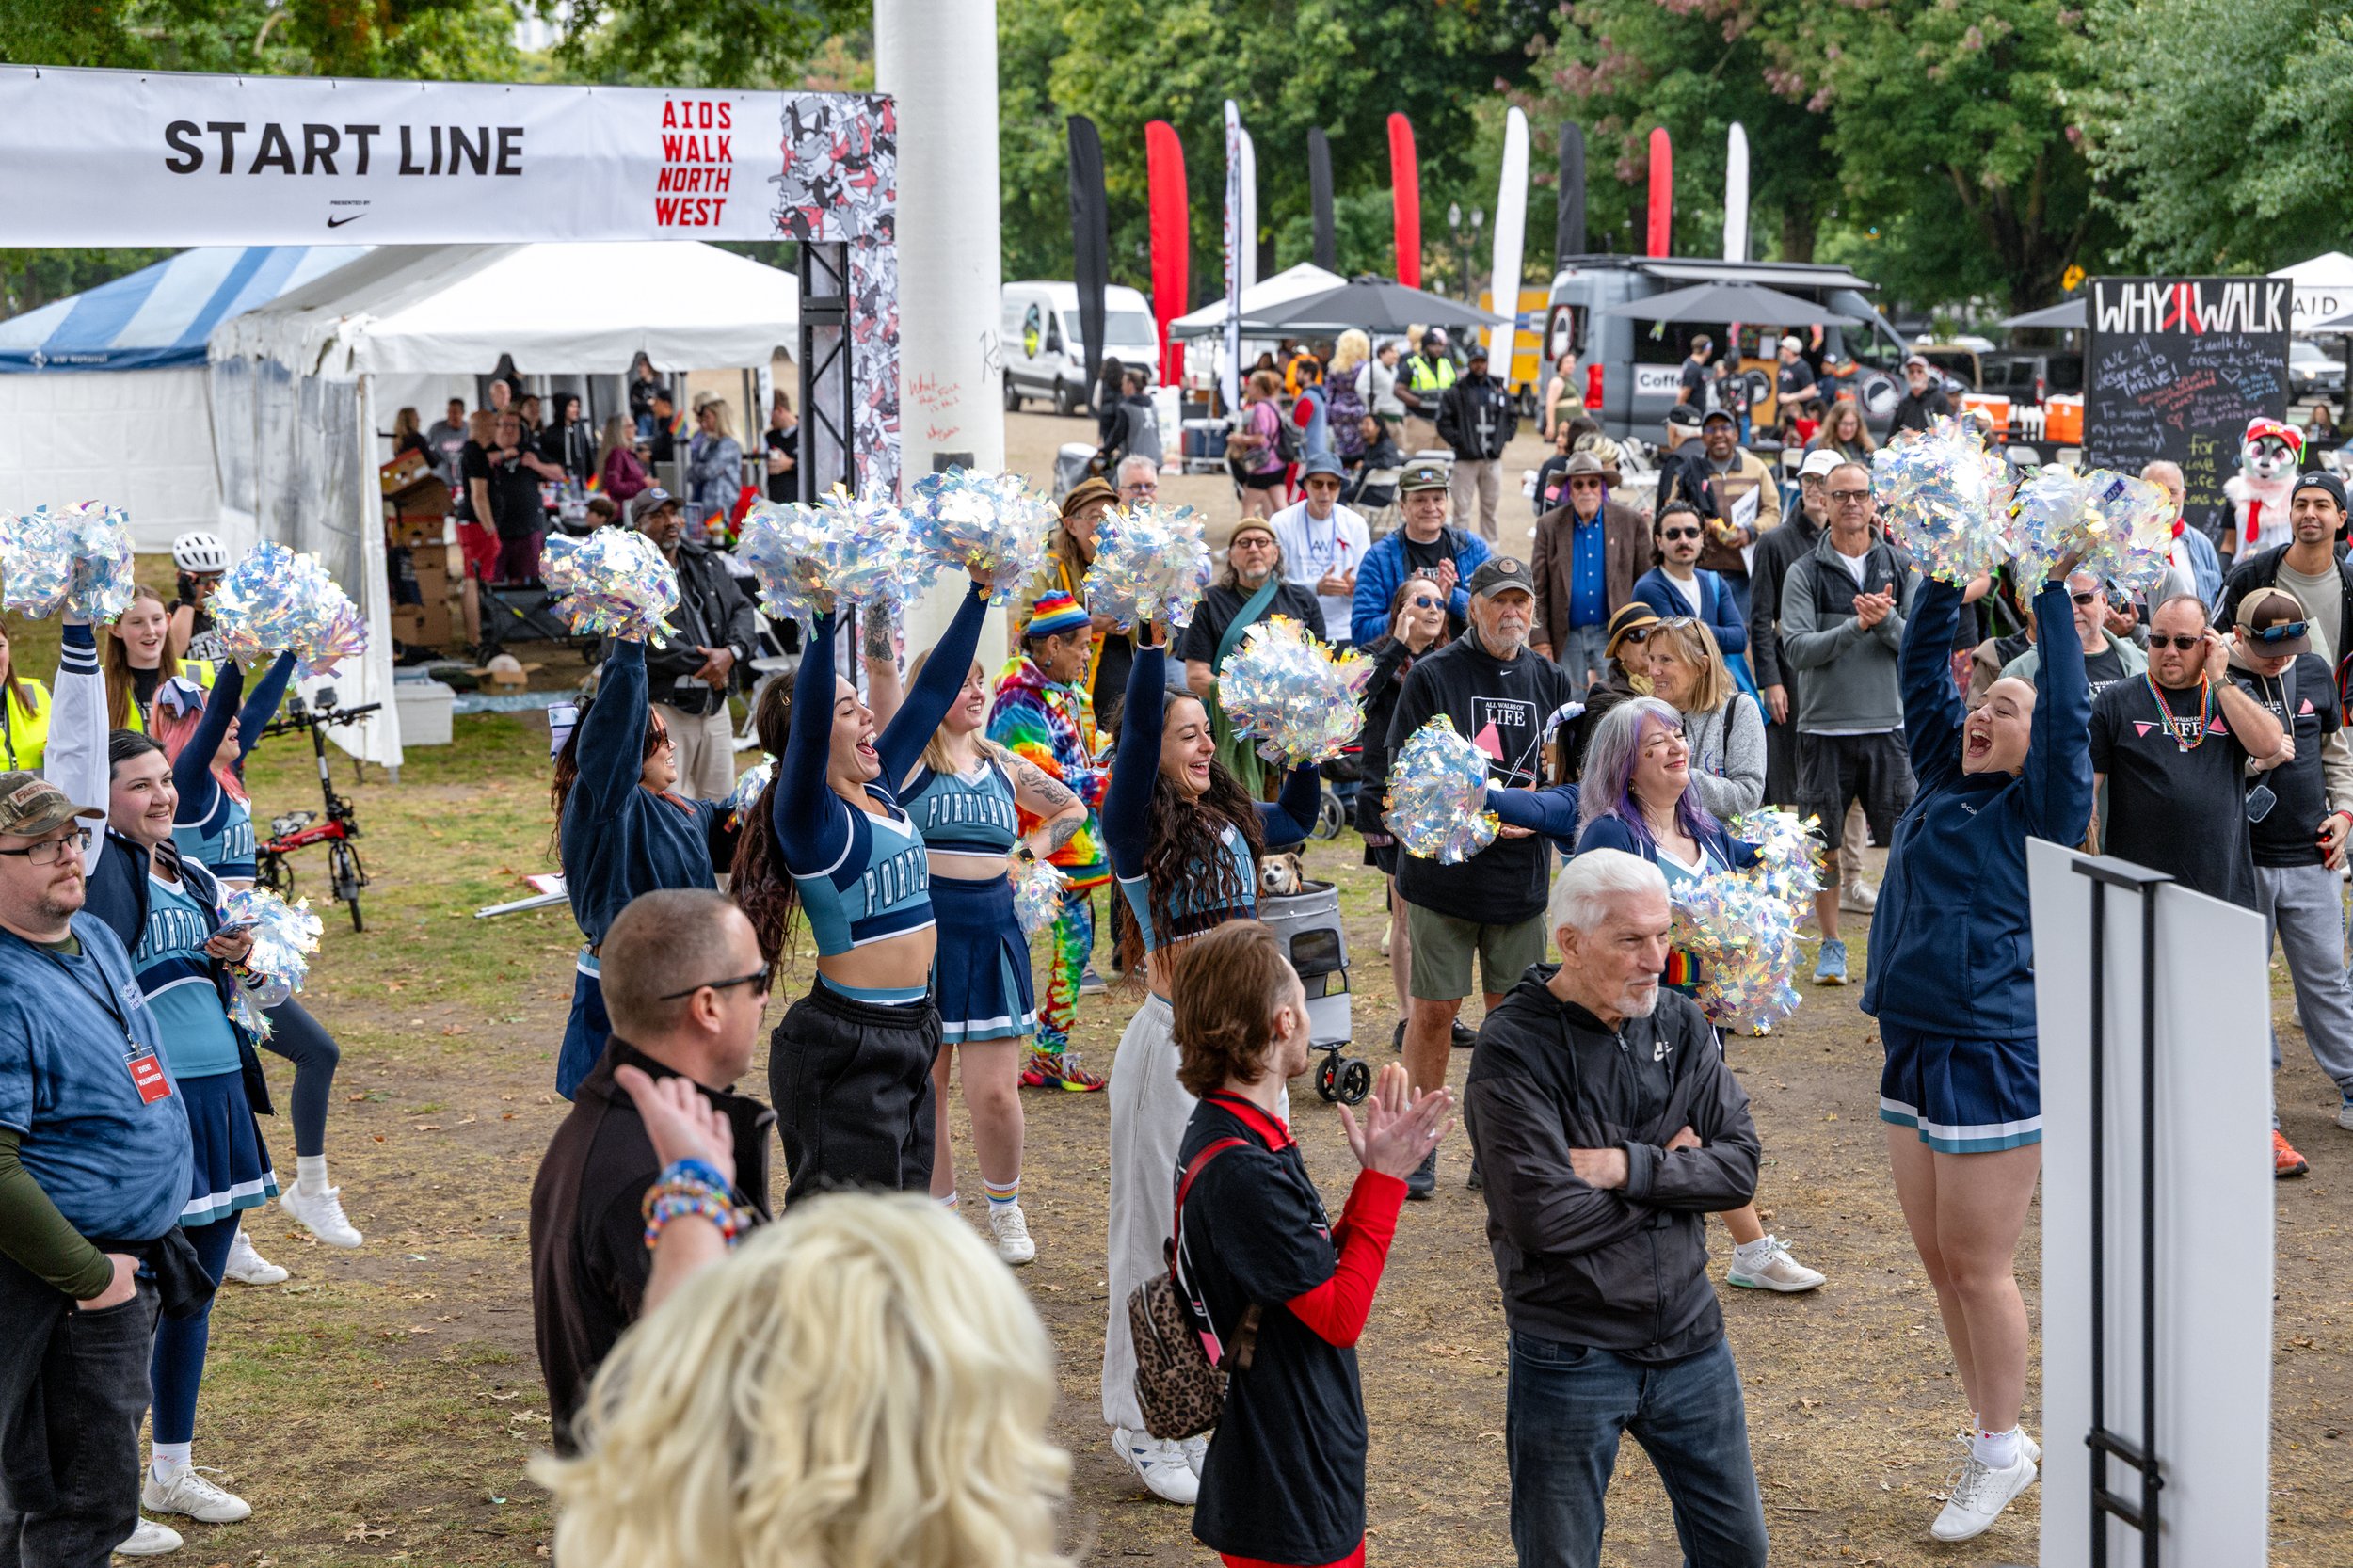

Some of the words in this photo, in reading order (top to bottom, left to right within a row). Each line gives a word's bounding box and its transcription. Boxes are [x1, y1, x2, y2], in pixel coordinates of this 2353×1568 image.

[662, 100, 731, 129] AIDS
[165, 120, 381, 175] START
[398, 125, 524, 176] LINE
[662, 135, 733, 163] WALK
[657, 168, 731, 192] NORTH
[655, 198, 727, 226] WEST
[2095, 282, 2175, 333] WHY
[2179, 283, 2188, 334] I
[2192, 282, 2285, 333] WALK
[1640, 373, 1683, 388] Coffe
[1485, 708, 1526, 727] LIFE
[862, 845, 929, 918] PORTL
[137, 1064, 152, 1073] EVENT
[137, 1072, 163, 1087] VOLUNTEER
